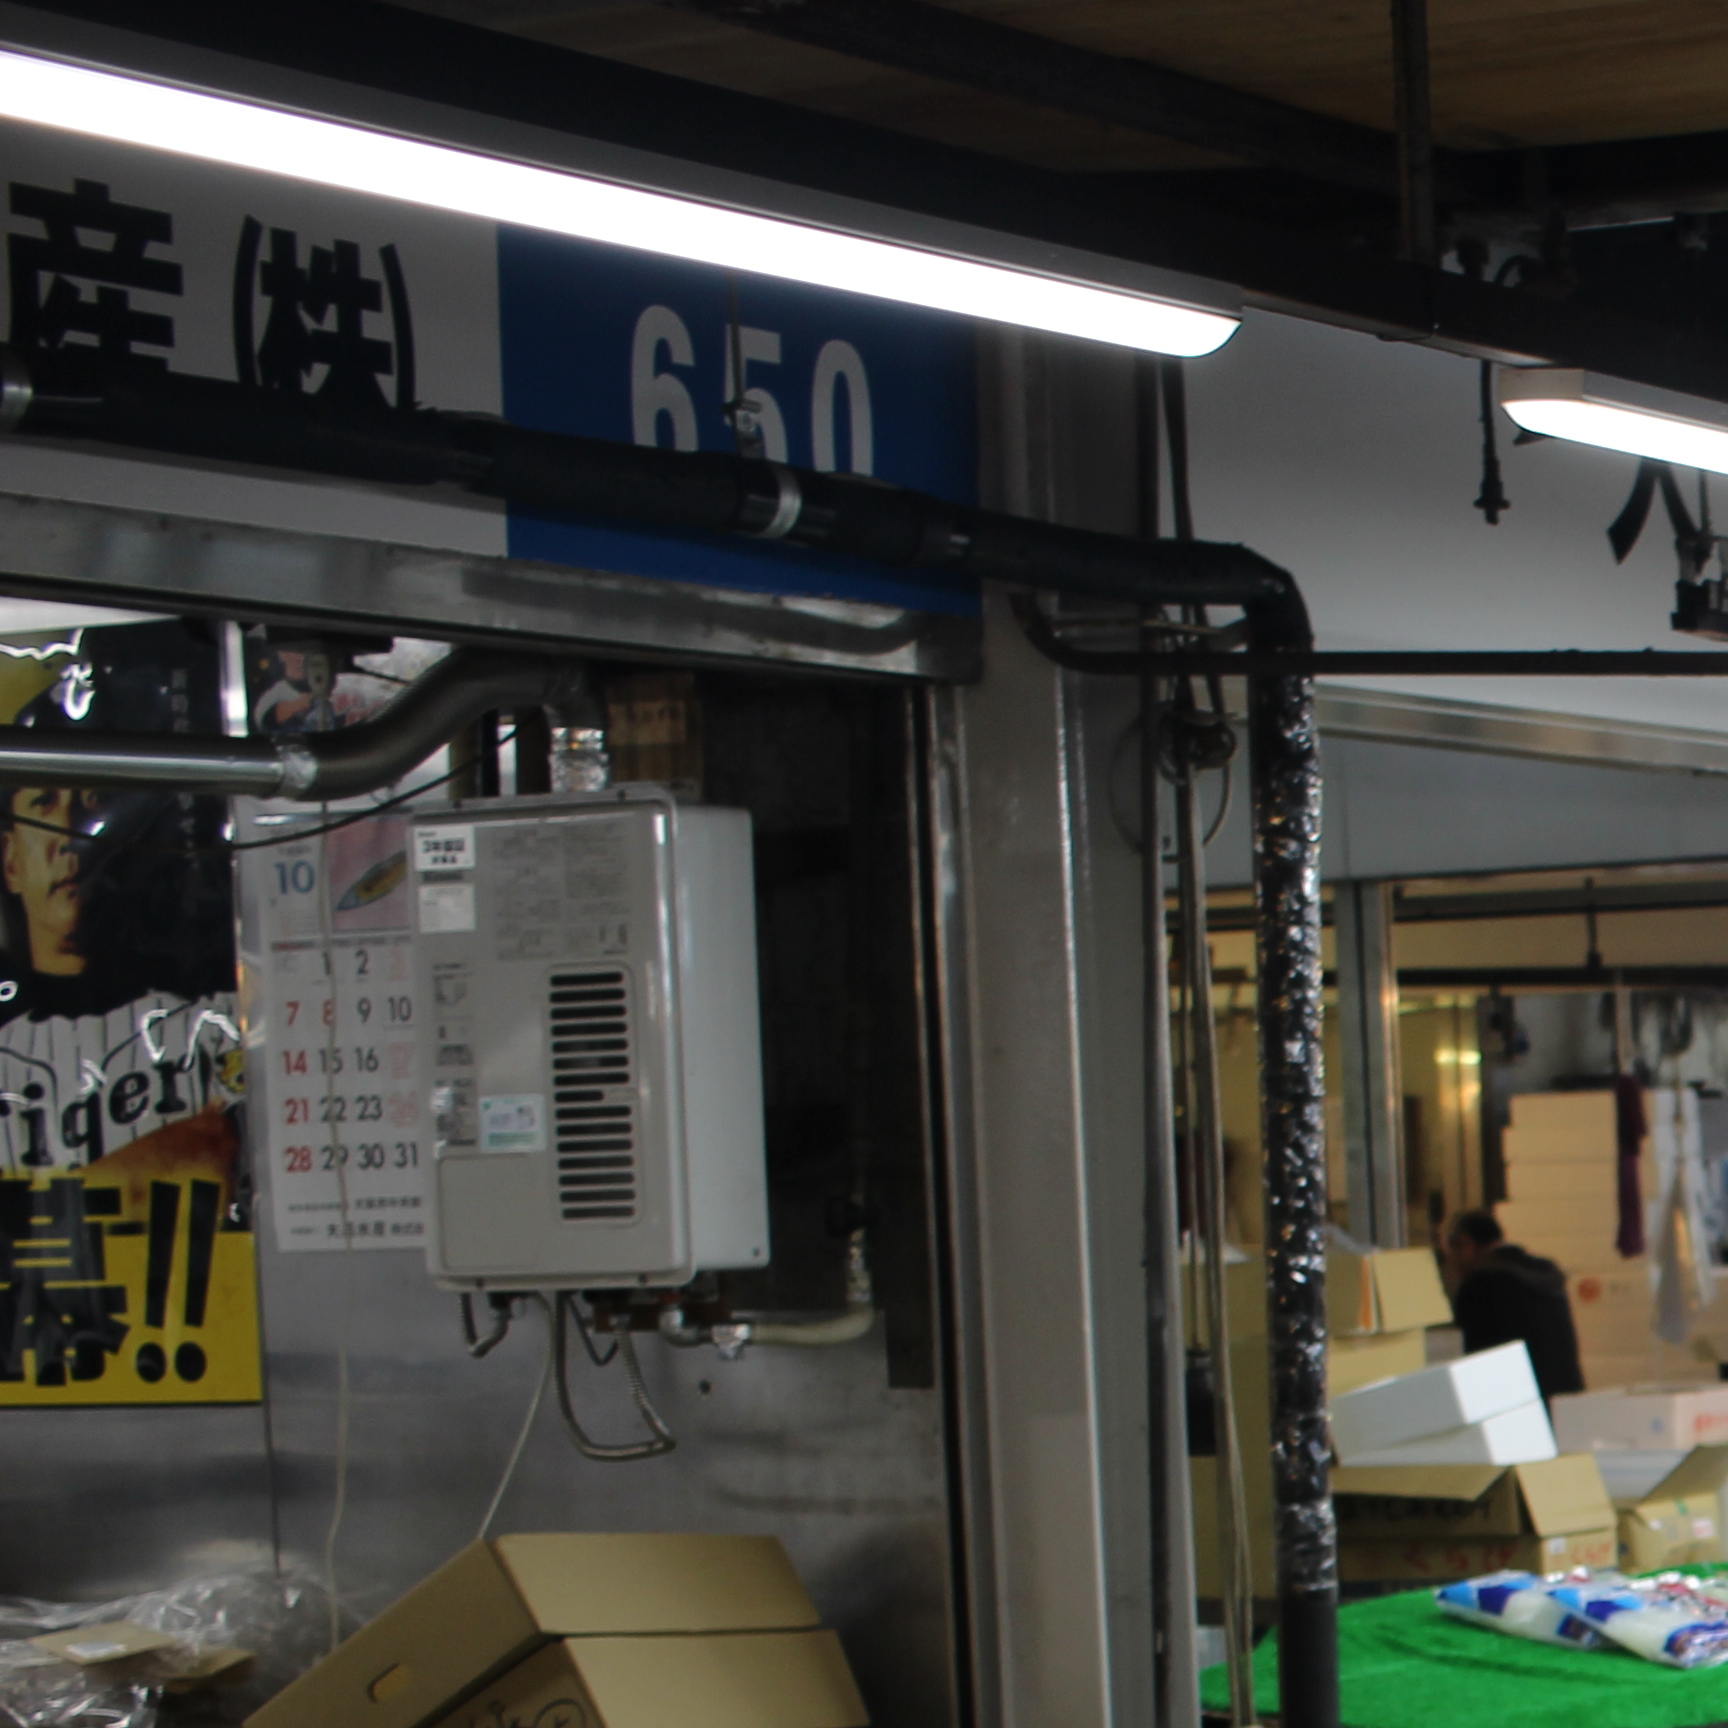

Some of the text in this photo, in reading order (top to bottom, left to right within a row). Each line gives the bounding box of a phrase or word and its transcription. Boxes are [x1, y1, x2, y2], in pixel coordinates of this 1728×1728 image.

[630, 304, 873, 477] 650
[274, 861, 315, 895] 10
[355, 949, 369, 976] 2
[287, 1000, 300, 1026] 7
[357, 998, 372, 1026] 9
[387, 995, 412, 1023] 10
[282, 1050, 308, 1077] 14
[318, 1048, 344, 1075] 15
[354, 1046, 379, 1073] 16
[284, 1099, 310, 1125] 21
[319, 1097, 347, 1123] 22
[355, 1095, 383, 1122] 23
[284, 1142, 419, 1174] 28 29 30 31
